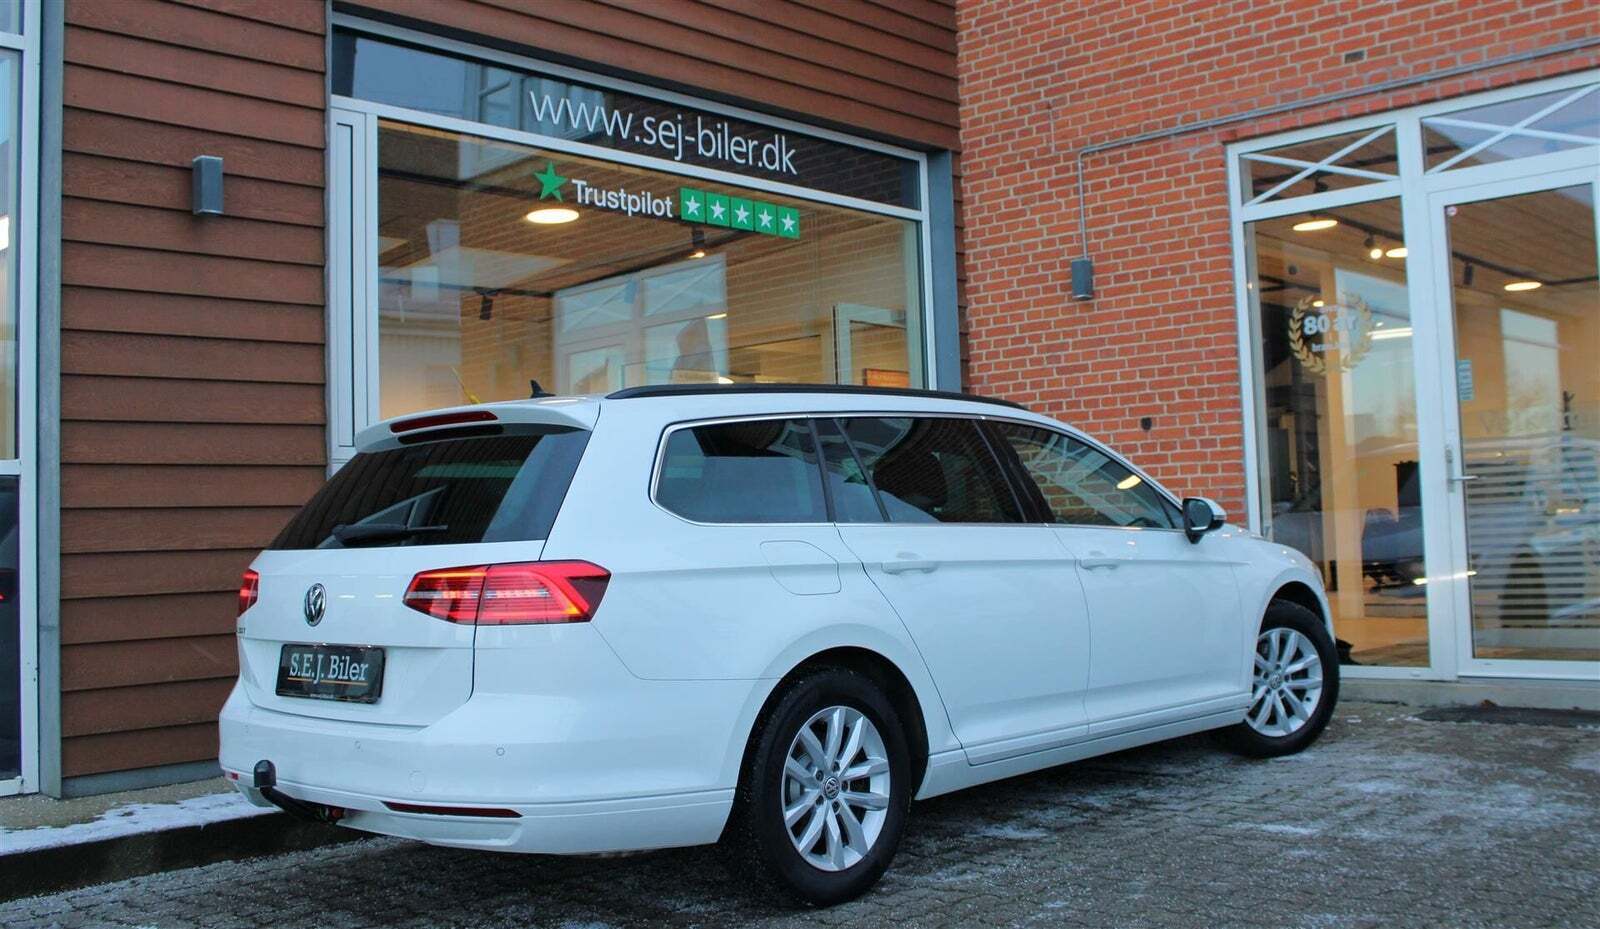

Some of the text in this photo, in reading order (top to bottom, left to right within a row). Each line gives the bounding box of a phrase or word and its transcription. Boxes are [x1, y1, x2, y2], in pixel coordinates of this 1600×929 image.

[529, 90, 798, 176] www.sej-biler.dk
[571, 178, 674, 218] Trustpilot
[1303, 315, 1330, 335] 80
[289, 652, 369, 684] S.E.J. Biler
